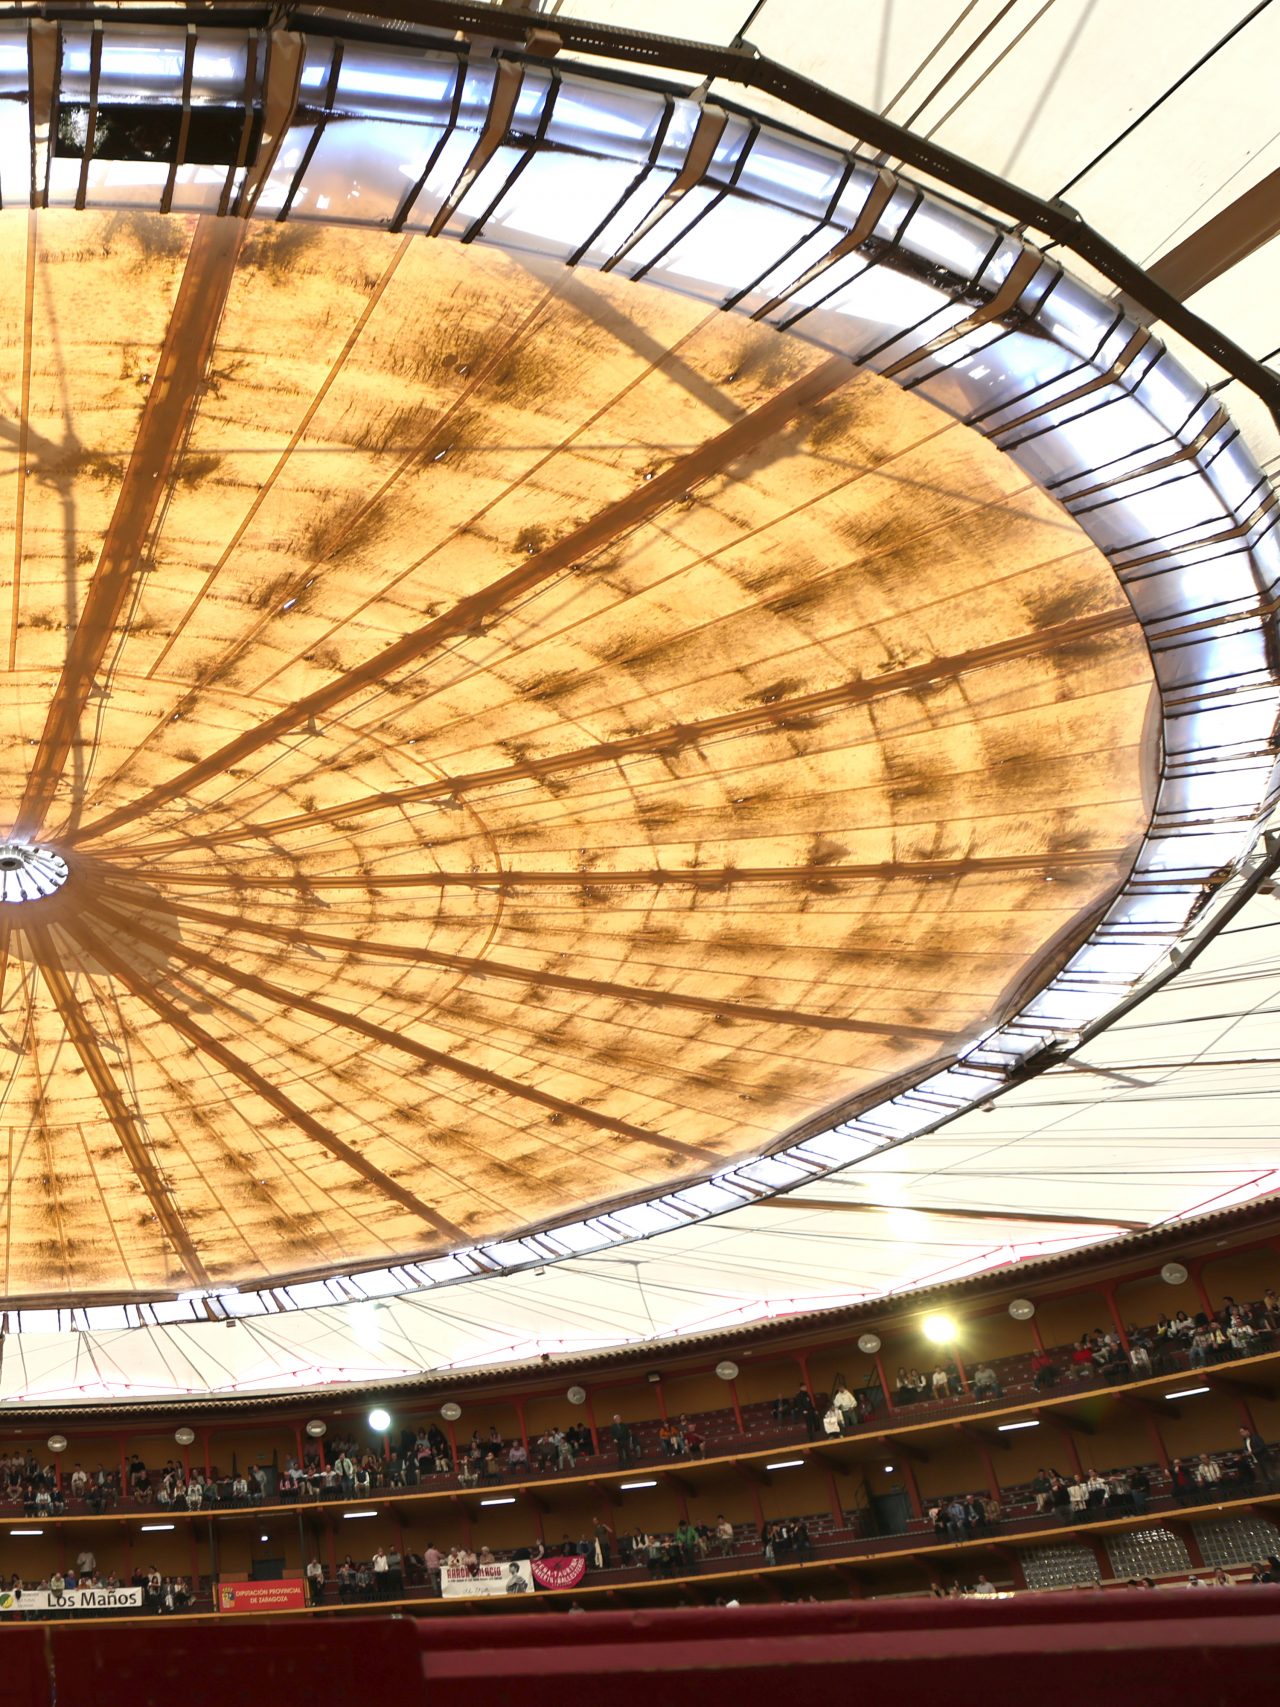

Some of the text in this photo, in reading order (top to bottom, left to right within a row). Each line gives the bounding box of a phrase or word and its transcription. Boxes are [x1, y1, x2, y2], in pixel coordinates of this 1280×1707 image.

[269, 1587, 301, 1595] PROVINCIAL
[48, 1593, 75, 1608] Los
[81, 1590, 137, 1607] Maños
